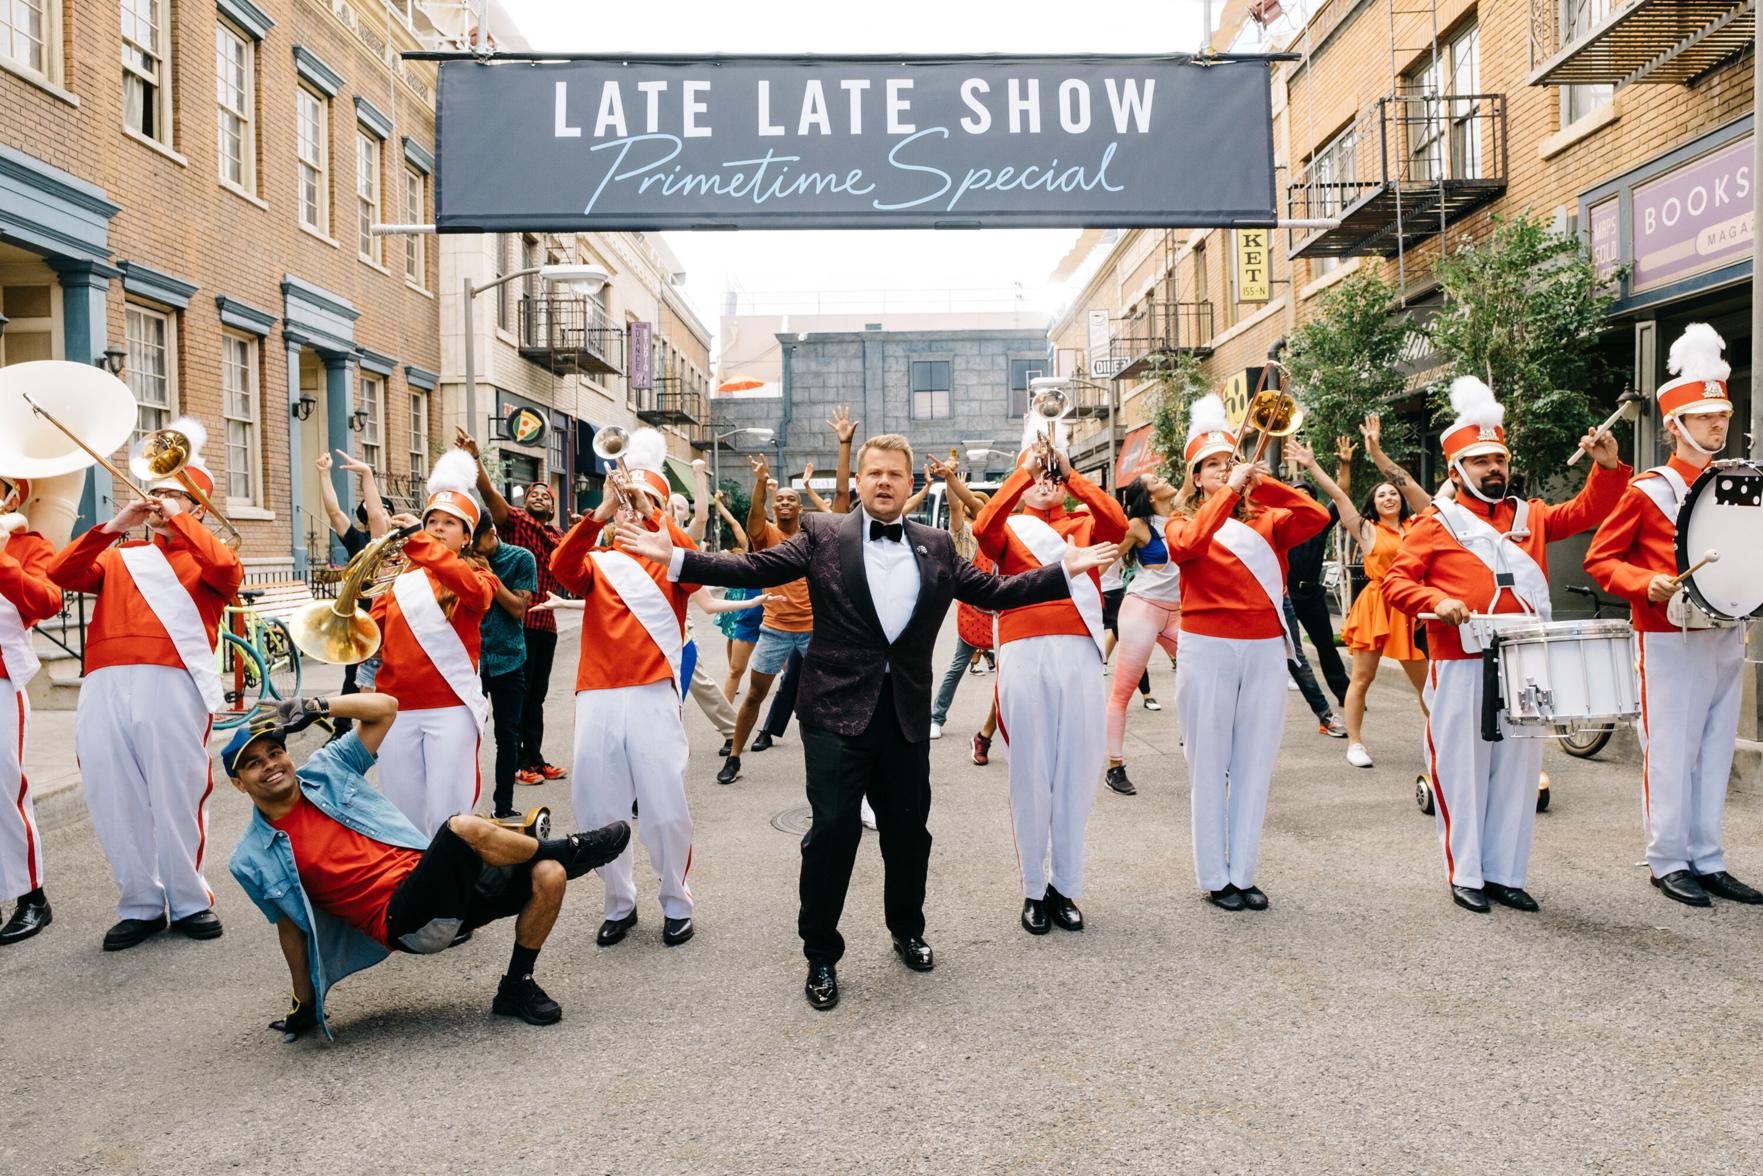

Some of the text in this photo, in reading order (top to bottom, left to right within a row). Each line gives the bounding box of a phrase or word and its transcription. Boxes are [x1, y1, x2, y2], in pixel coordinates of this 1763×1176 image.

[554, 77, 1156, 138] LATE LATE SHOW
[584, 126, 1124, 215] Primetime Special
[1645, 166, 1750, 235] BOOKS
[1243, 233, 1263, 283] KET
[1707, 217, 1754, 247] MAGA
